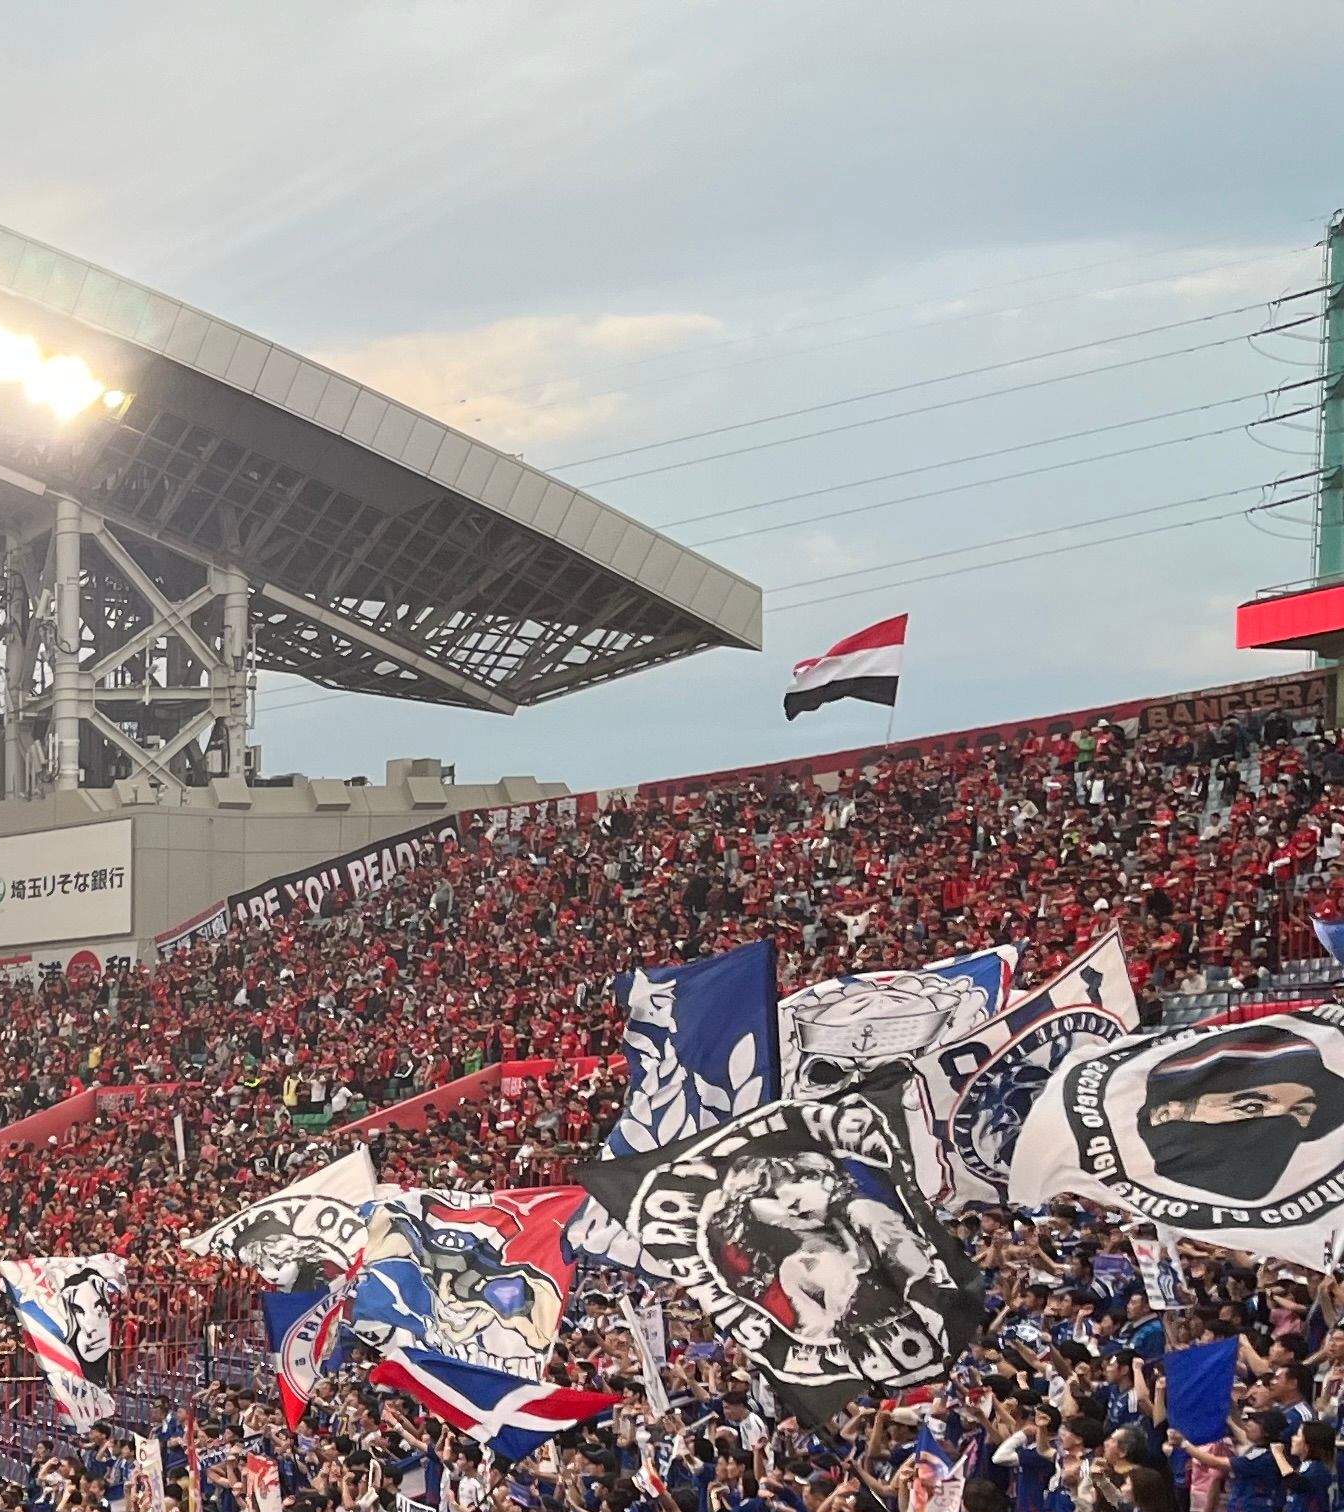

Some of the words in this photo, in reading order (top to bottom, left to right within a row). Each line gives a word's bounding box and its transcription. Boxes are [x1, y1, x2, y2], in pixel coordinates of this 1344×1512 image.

[10, 866, 125, 901] 埼玉りそな銀行
